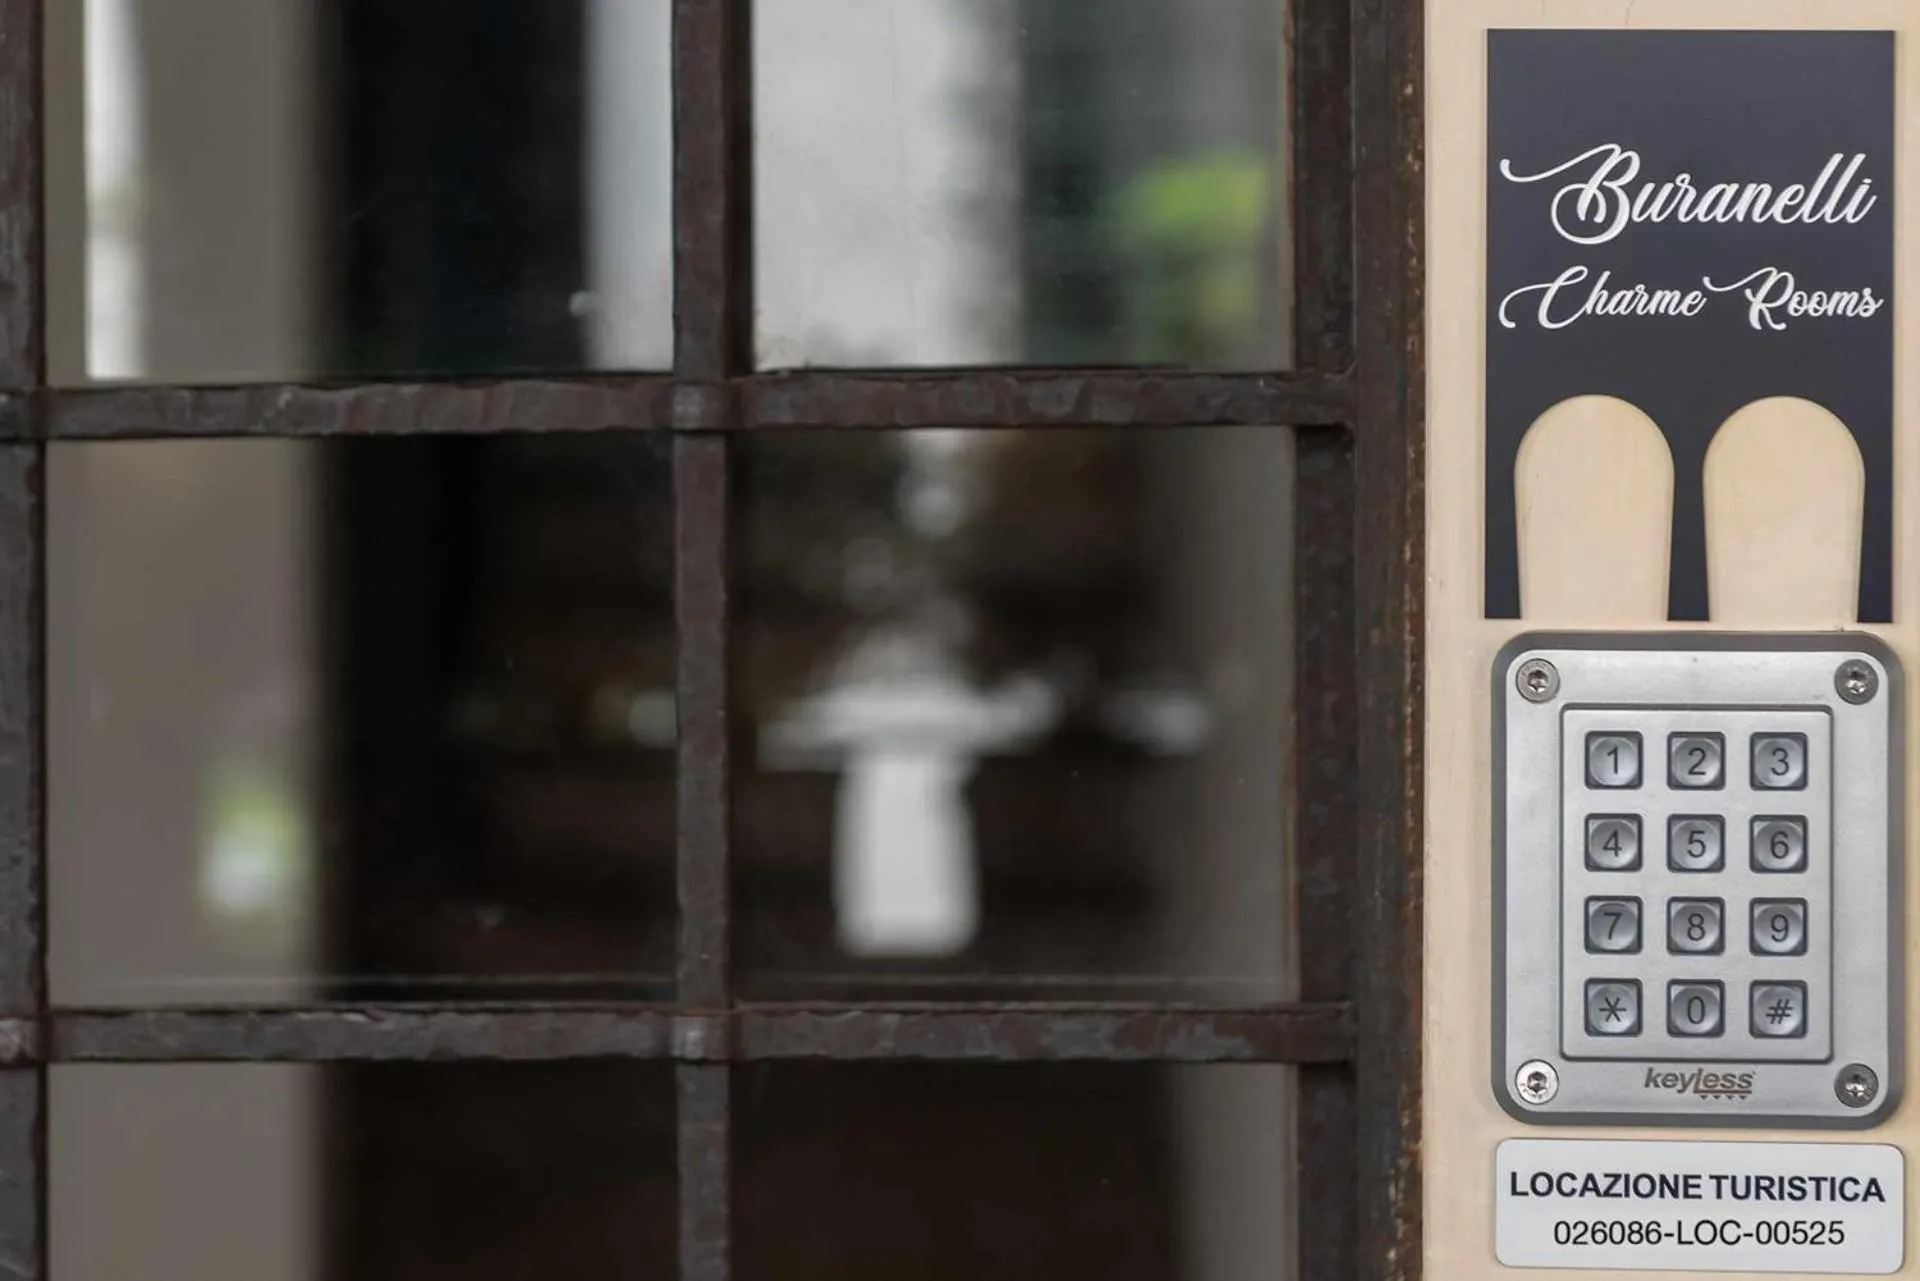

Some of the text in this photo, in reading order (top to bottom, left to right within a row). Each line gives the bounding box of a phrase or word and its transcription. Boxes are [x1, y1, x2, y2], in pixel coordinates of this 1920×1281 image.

[1500, 143, 1877, 244] Buranelli
[1499, 265, 1883, 330] Charme Rooms
[1606, 747, 1789, 776] 1 2 3
[1602, 830, 1789, 859] 4 5 6
[1604, 912, 1789, 942] 7 8 9
[1687, 996, 1705, 1025] 0
[1644, 1067, 1753, 1095] keyless
[1511, 1172, 1886, 1203] LOCAZIONE TURISTICA
[1554, 1220, 1845, 1246] 026086-LOC-00525
